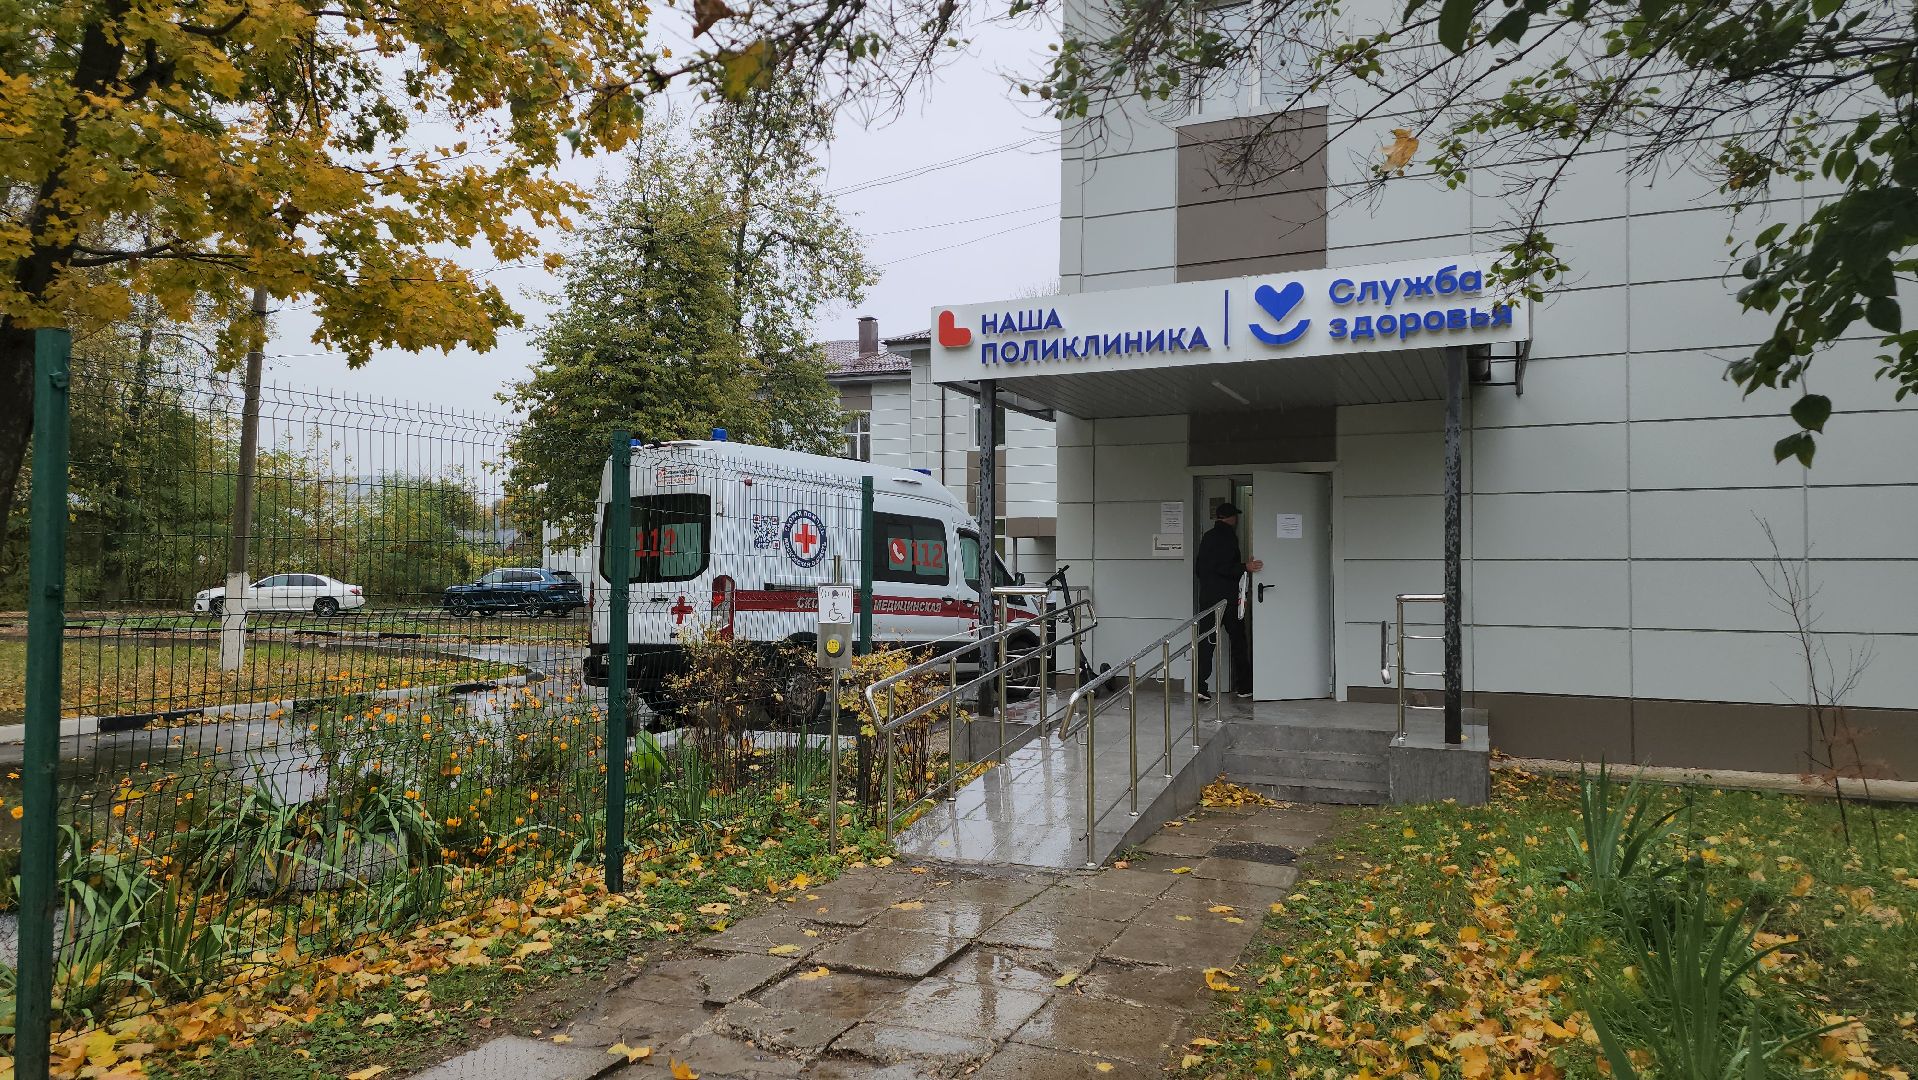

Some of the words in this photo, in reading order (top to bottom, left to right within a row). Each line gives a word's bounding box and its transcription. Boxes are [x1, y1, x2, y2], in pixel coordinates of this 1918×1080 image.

[1329, 264, 1482, 307] Служба
[981, 308, 1063, 335] НАША
[1329, 304, 1513, 341] здоровья
[981, 326, 1210, 364] ПОЛИКЛИНИКА
[635, 527, 677, 558] 112
[911, 541, 944, 569] 112
[873, 599, 942, 613] МЕДИЦИНСКАЯ
